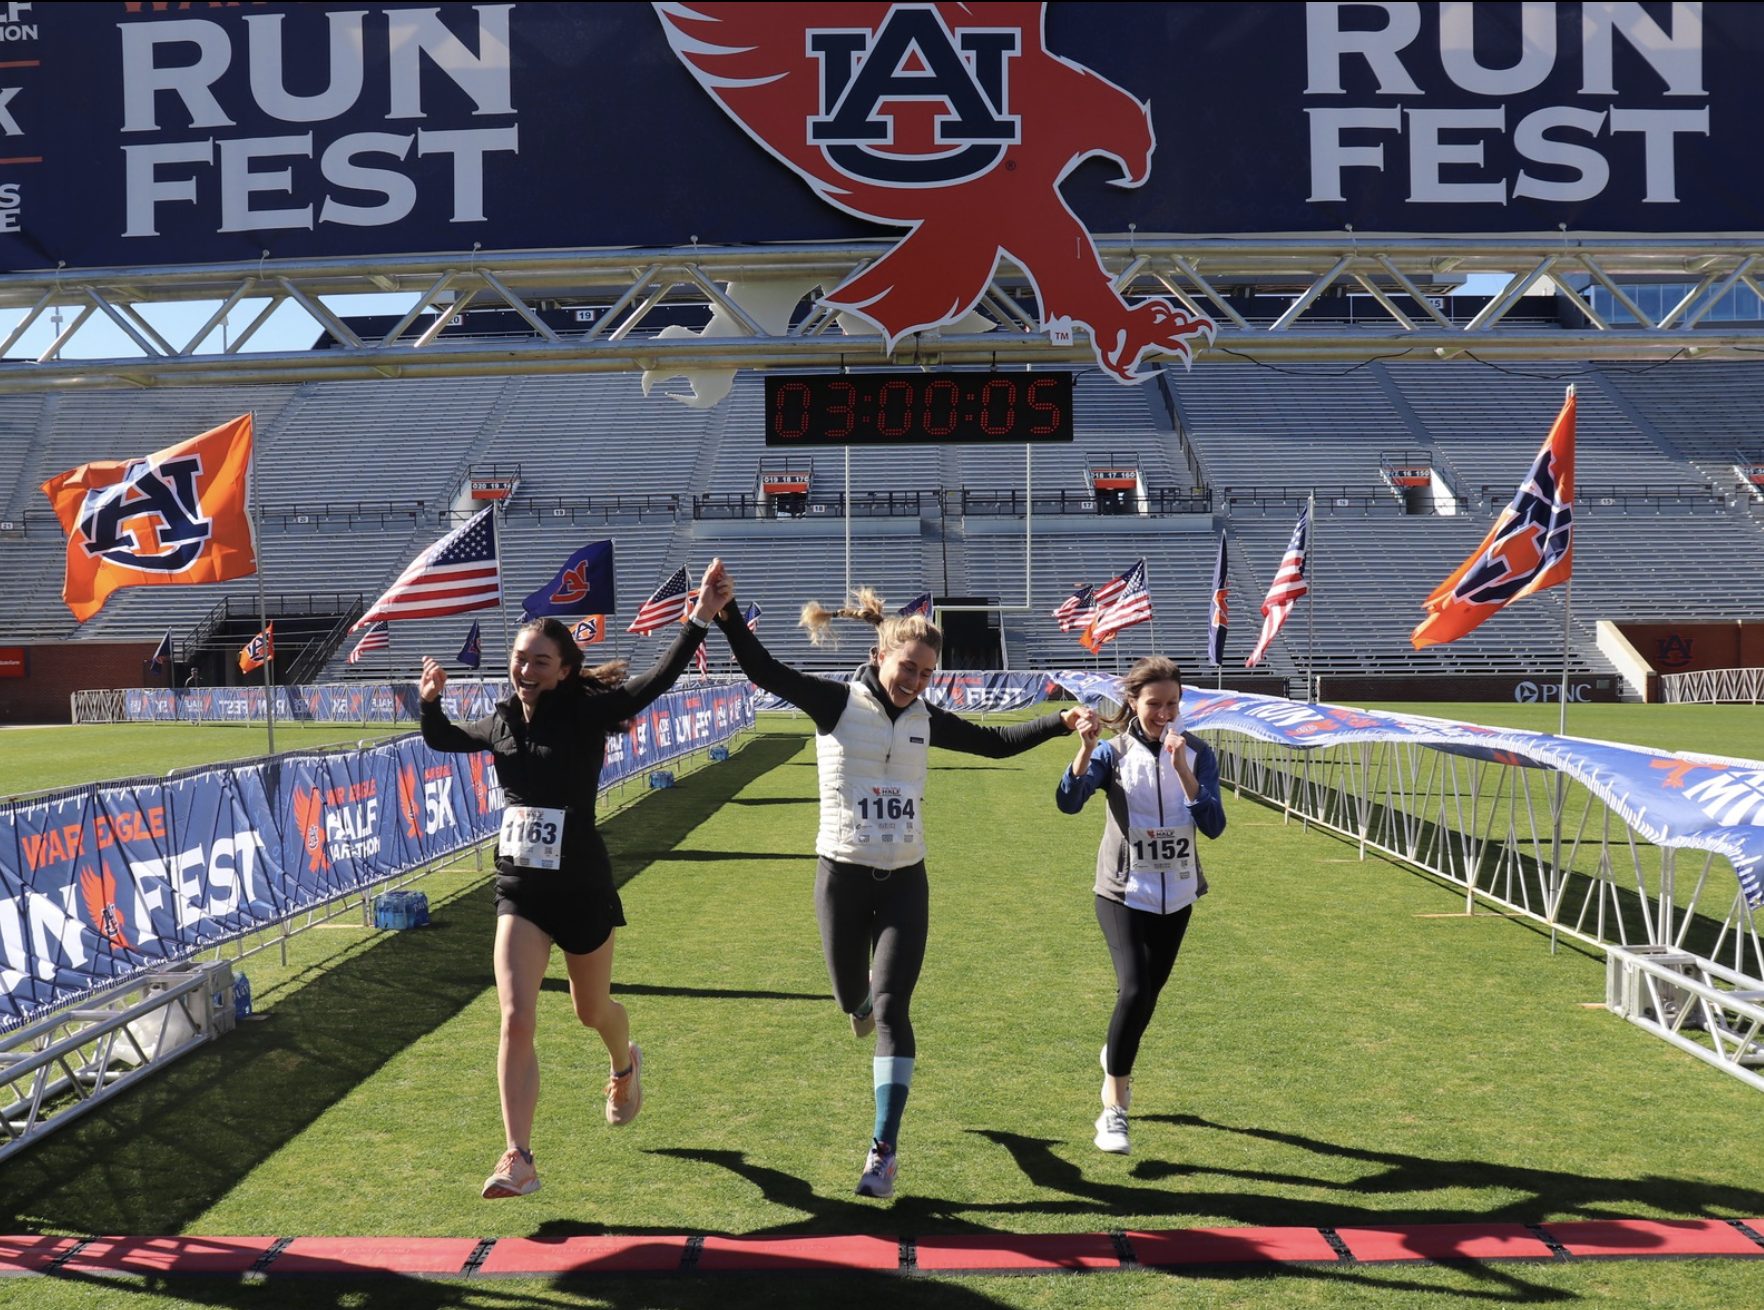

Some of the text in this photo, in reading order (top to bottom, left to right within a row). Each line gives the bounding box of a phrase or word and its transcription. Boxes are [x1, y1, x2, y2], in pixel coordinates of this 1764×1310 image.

[116, 4, 518, 132] RUN
[1303, 2, 1709, 96] RUN
[1303, 104, 1709, 206] FEST
[120, 123, 519, 238] FEST
[579, 311, 592, 321] 19
[1055, 331, 1070, 341] TM
[775, 379, 1061, 438] 03:00:05
[966, 687, 1024, 704] FEST
[1541, 684, 1592, 703] PNC
[425, 776, 456, 835] 5K
[857, 797, 915, 820] 1164
[22, 823, 86, 872] WAR
[506, 820, 557, 845] 1163
[1133, 838, 1190, 860] 1152
[129, 830, 267, 946] FEST
